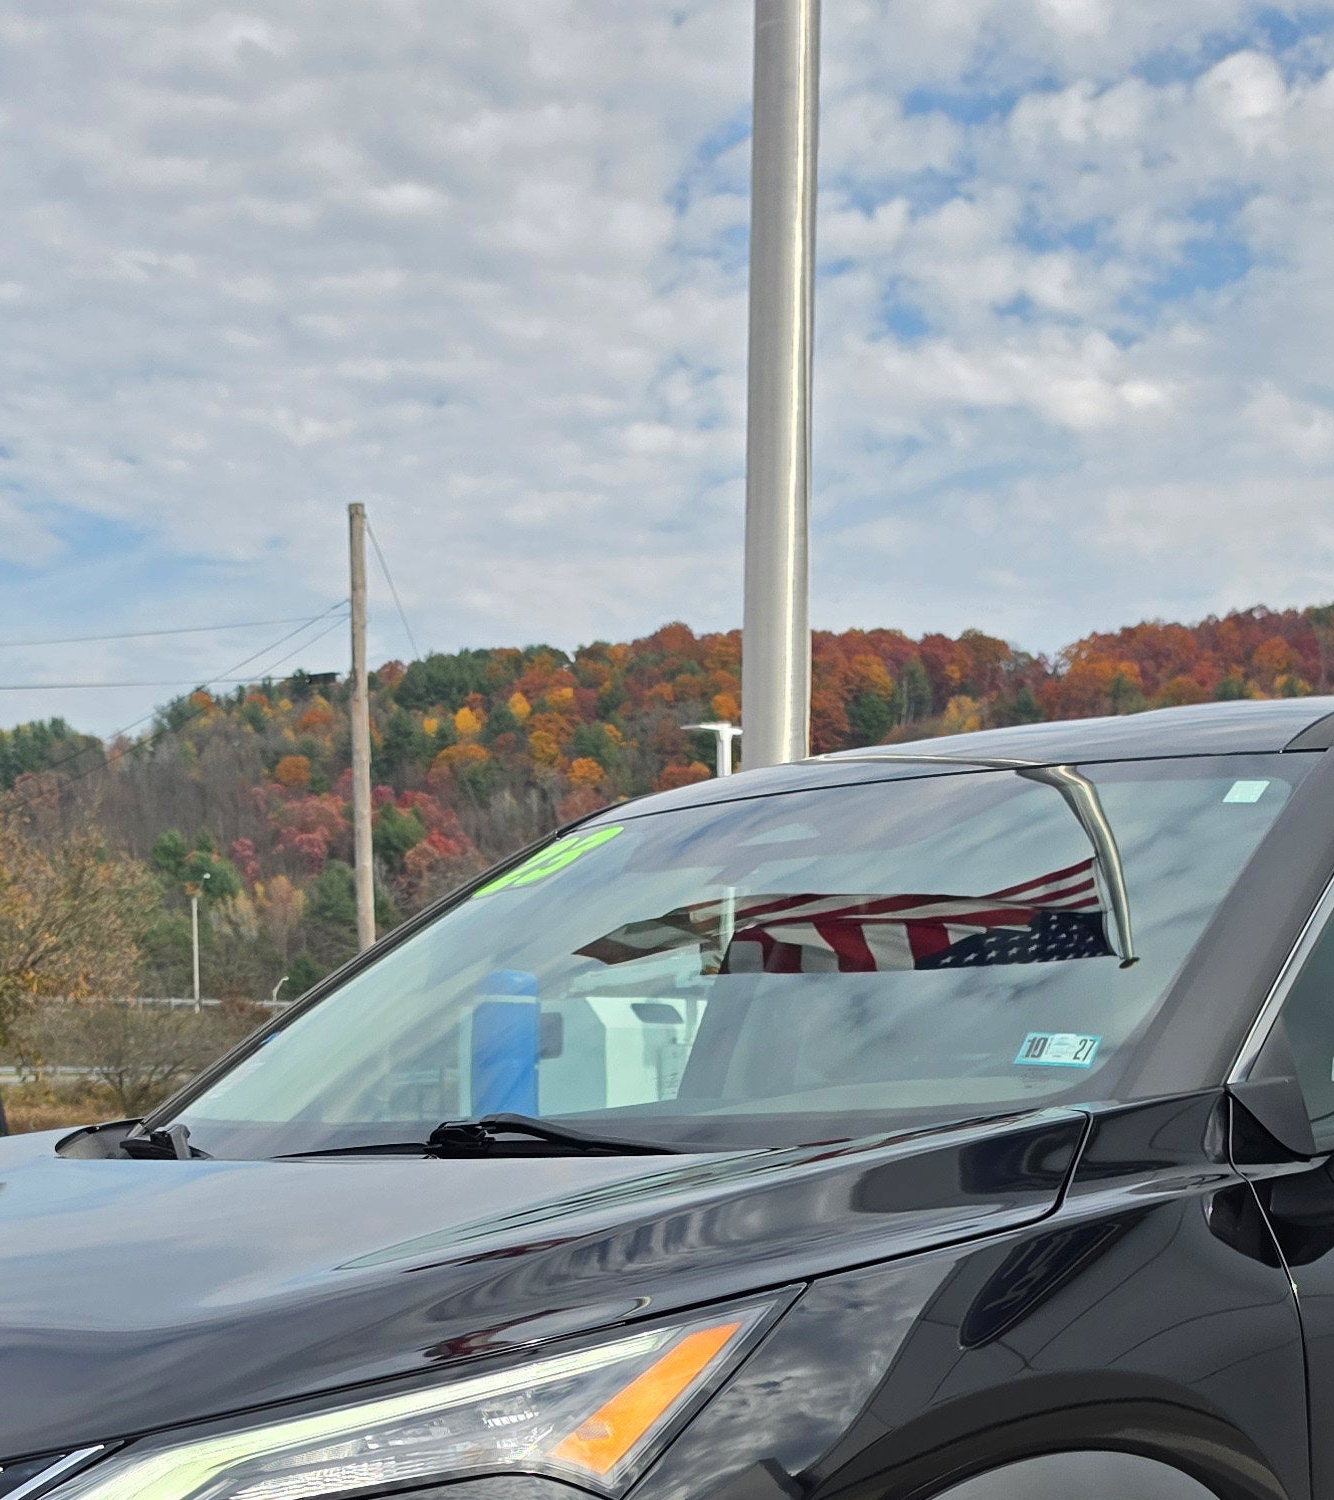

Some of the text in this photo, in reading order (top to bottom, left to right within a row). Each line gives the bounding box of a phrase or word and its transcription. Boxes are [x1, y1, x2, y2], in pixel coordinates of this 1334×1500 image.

[471, 825, 625, 900] 23
[1024, 1036, 1049, 1059] 10
[1072, 1038, 1097, 1062] 27
